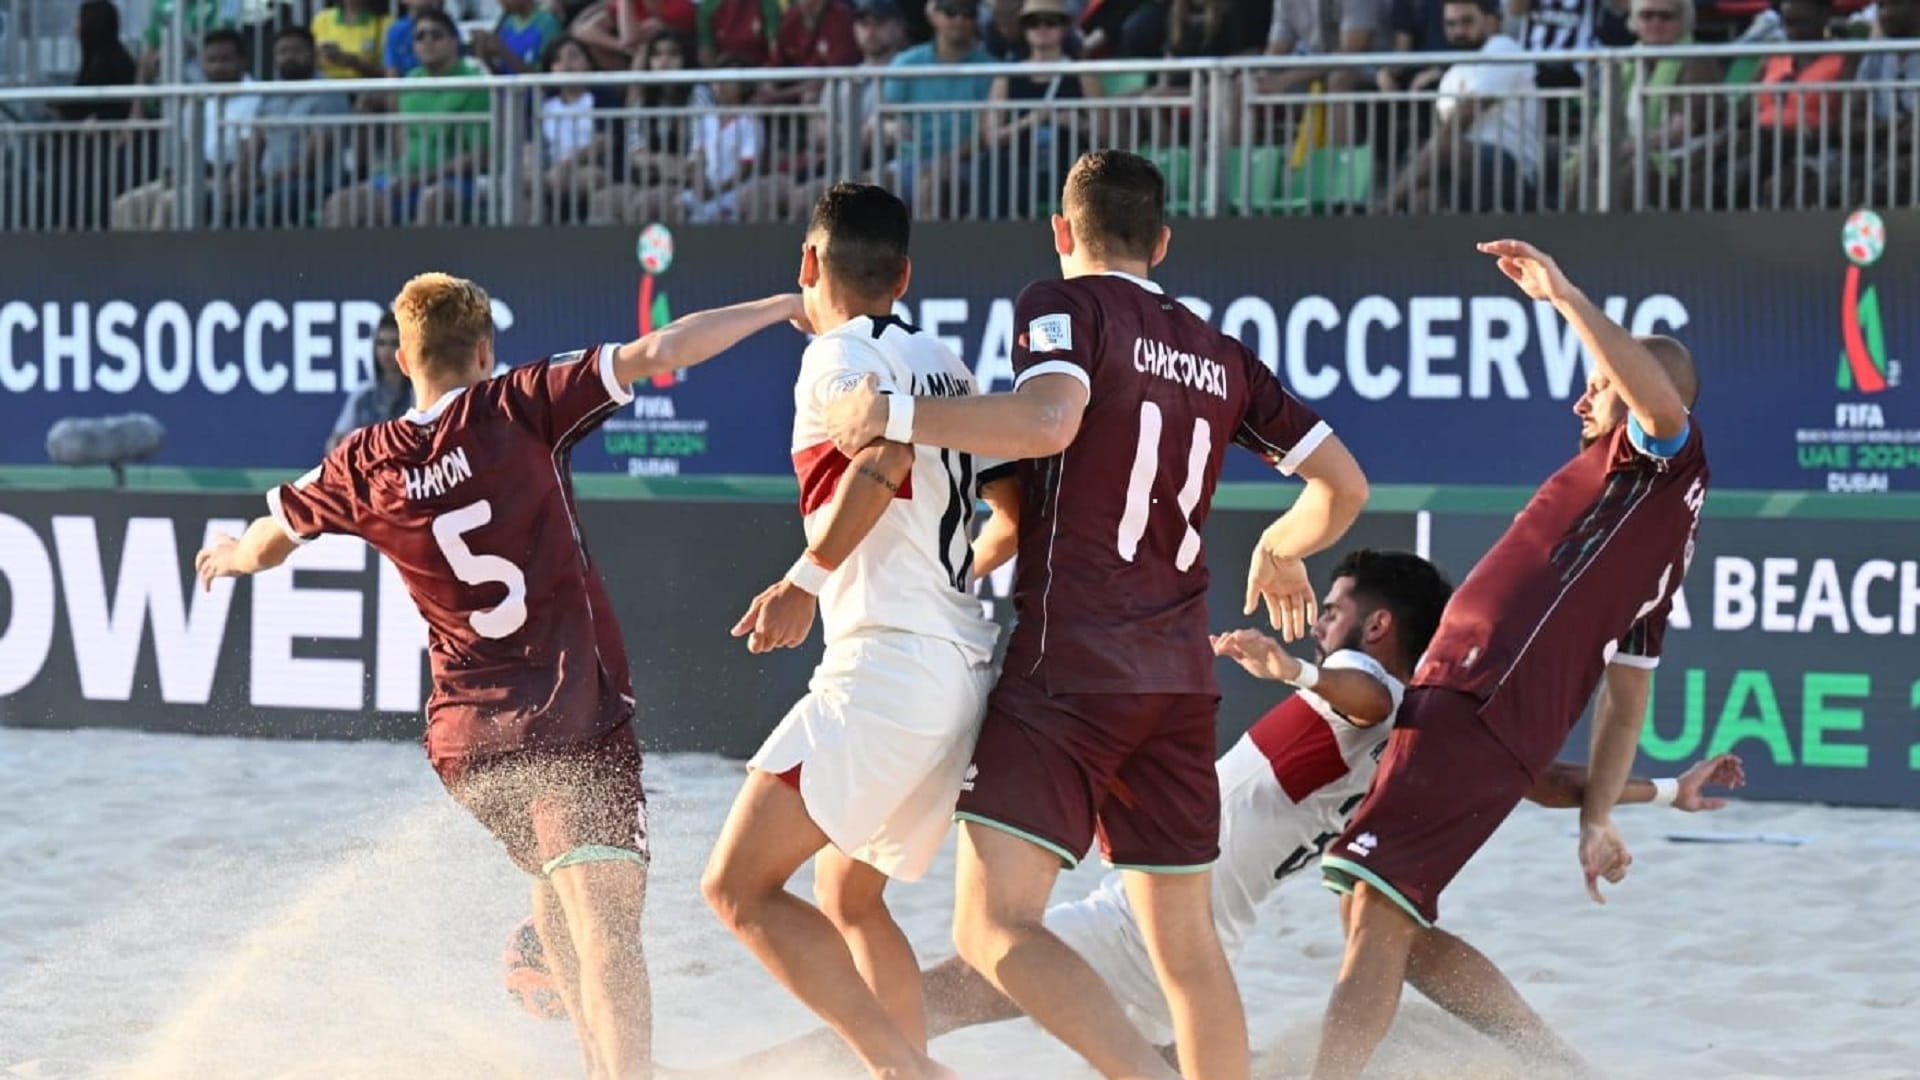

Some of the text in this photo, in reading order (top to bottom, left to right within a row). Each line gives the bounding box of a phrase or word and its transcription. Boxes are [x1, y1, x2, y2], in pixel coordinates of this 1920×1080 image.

[0, 299, 514, 394] CHSOCCER
[634, 396, 675, 419] FIFA
[1835, 402, 1885, 429] FIFA
[402, 446, 473, 500] HAPON
[1798, 444, 1920, 470] UAE 2024
[1826, 473, 1888, 493] DUBAI
[1117, 400, 1212, 573] 11
[432, 499, 528, 639] 5
[1636, 668, 1871, 768] UAE
